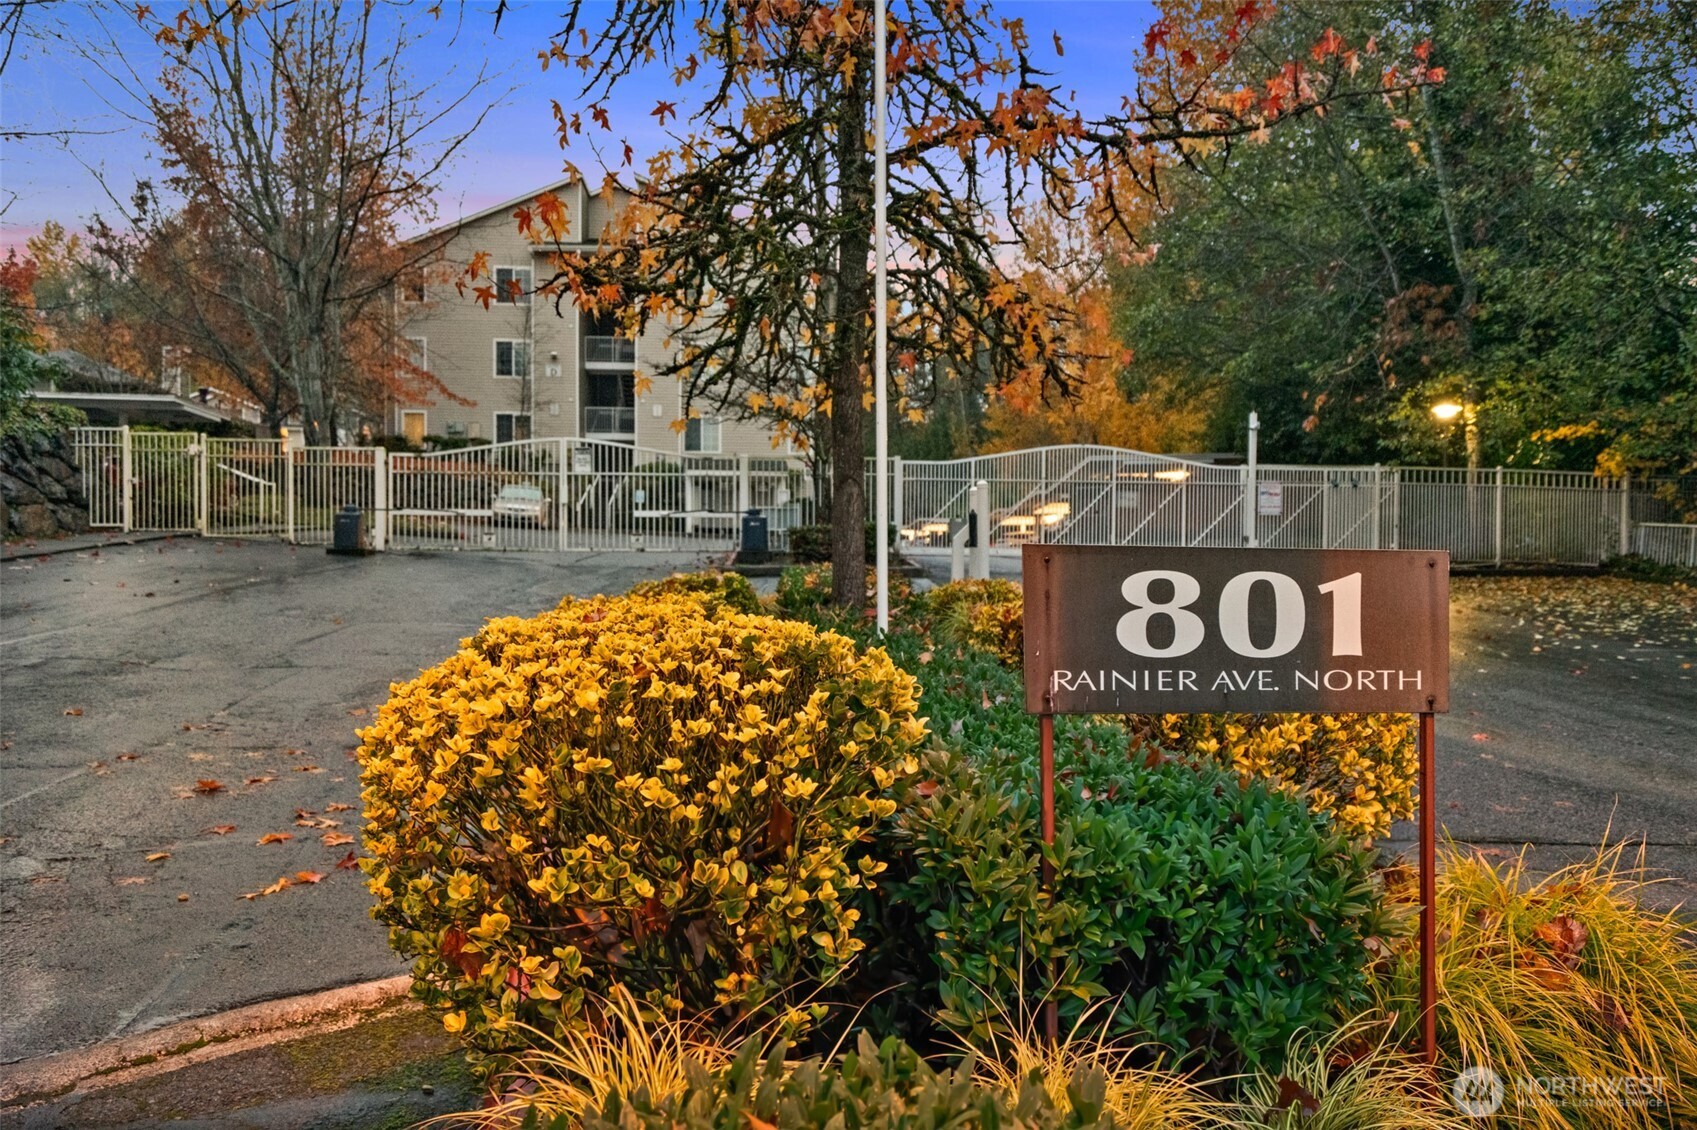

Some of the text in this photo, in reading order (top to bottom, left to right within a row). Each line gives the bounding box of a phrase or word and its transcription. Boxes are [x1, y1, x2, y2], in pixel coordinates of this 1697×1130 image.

[1116, 570, 1363, 658] 801
[1053, 670, 1422, 691] RAINIER AVE. NORTH
